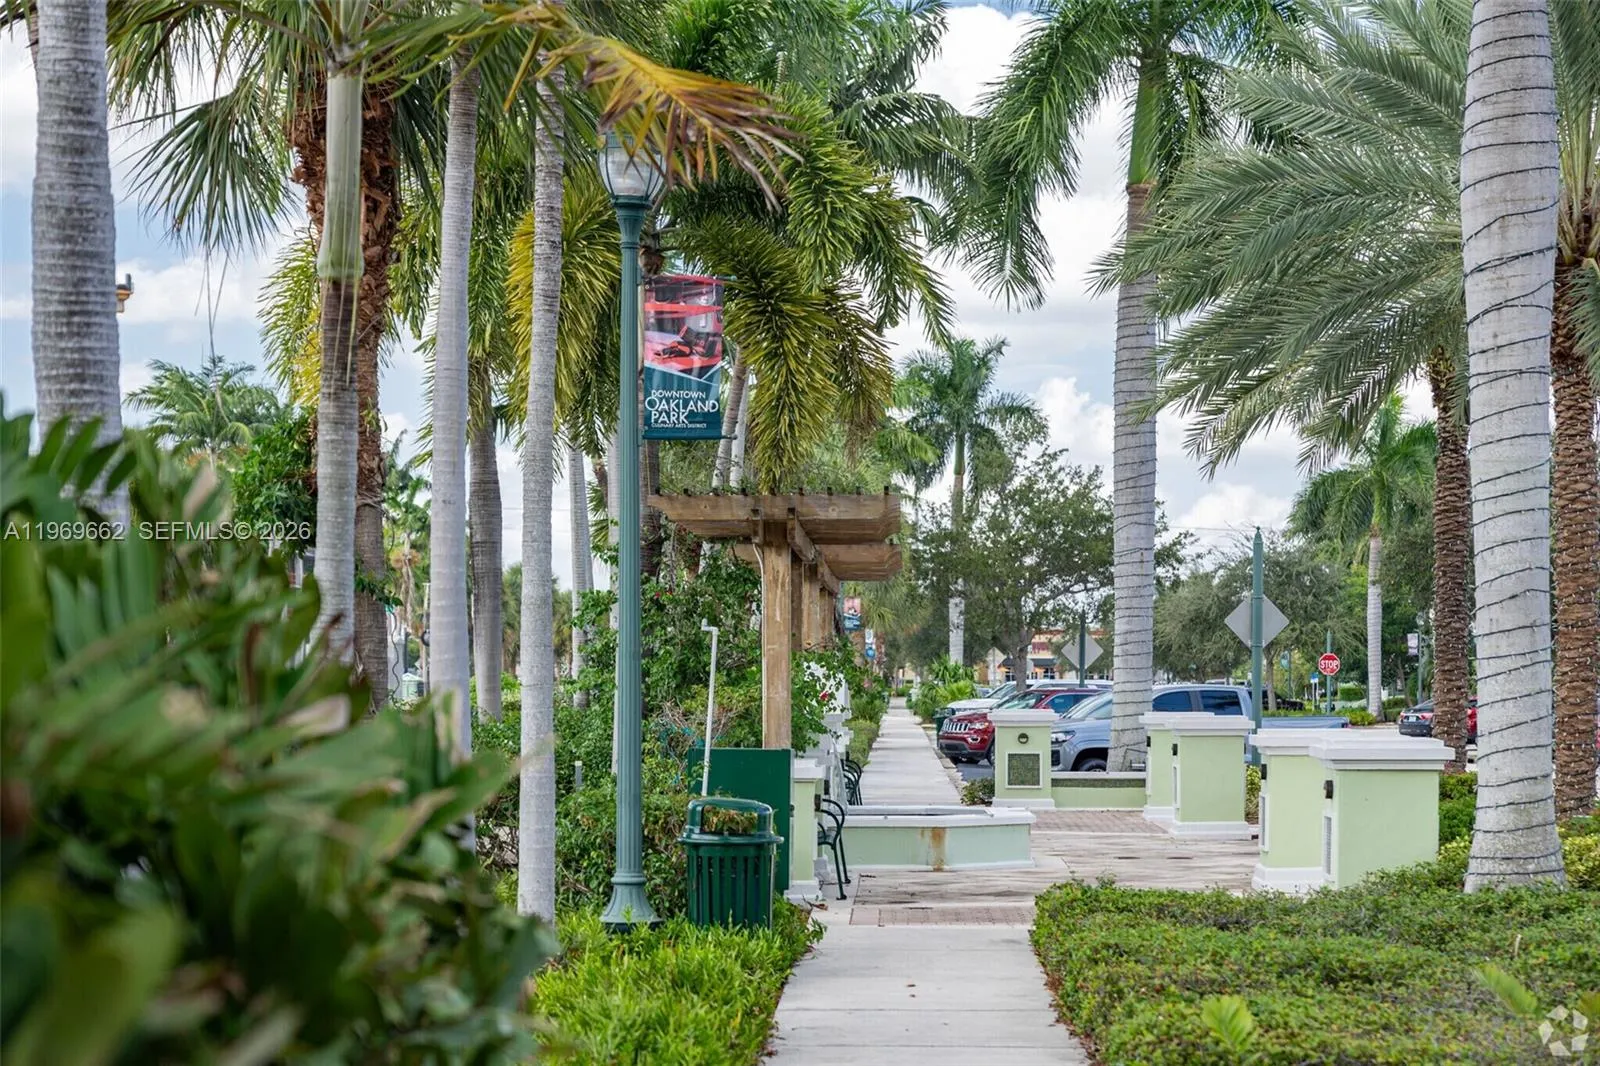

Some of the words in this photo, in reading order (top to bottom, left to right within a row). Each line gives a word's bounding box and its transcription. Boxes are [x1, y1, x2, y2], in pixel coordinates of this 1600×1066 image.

[651, 389, 706, 399] DOWNTOWN
[645, 396, 719, 413] OAKLAND
[651, 410, 689, 424] PARK
[1320, 659, 1339, 669] STOP
